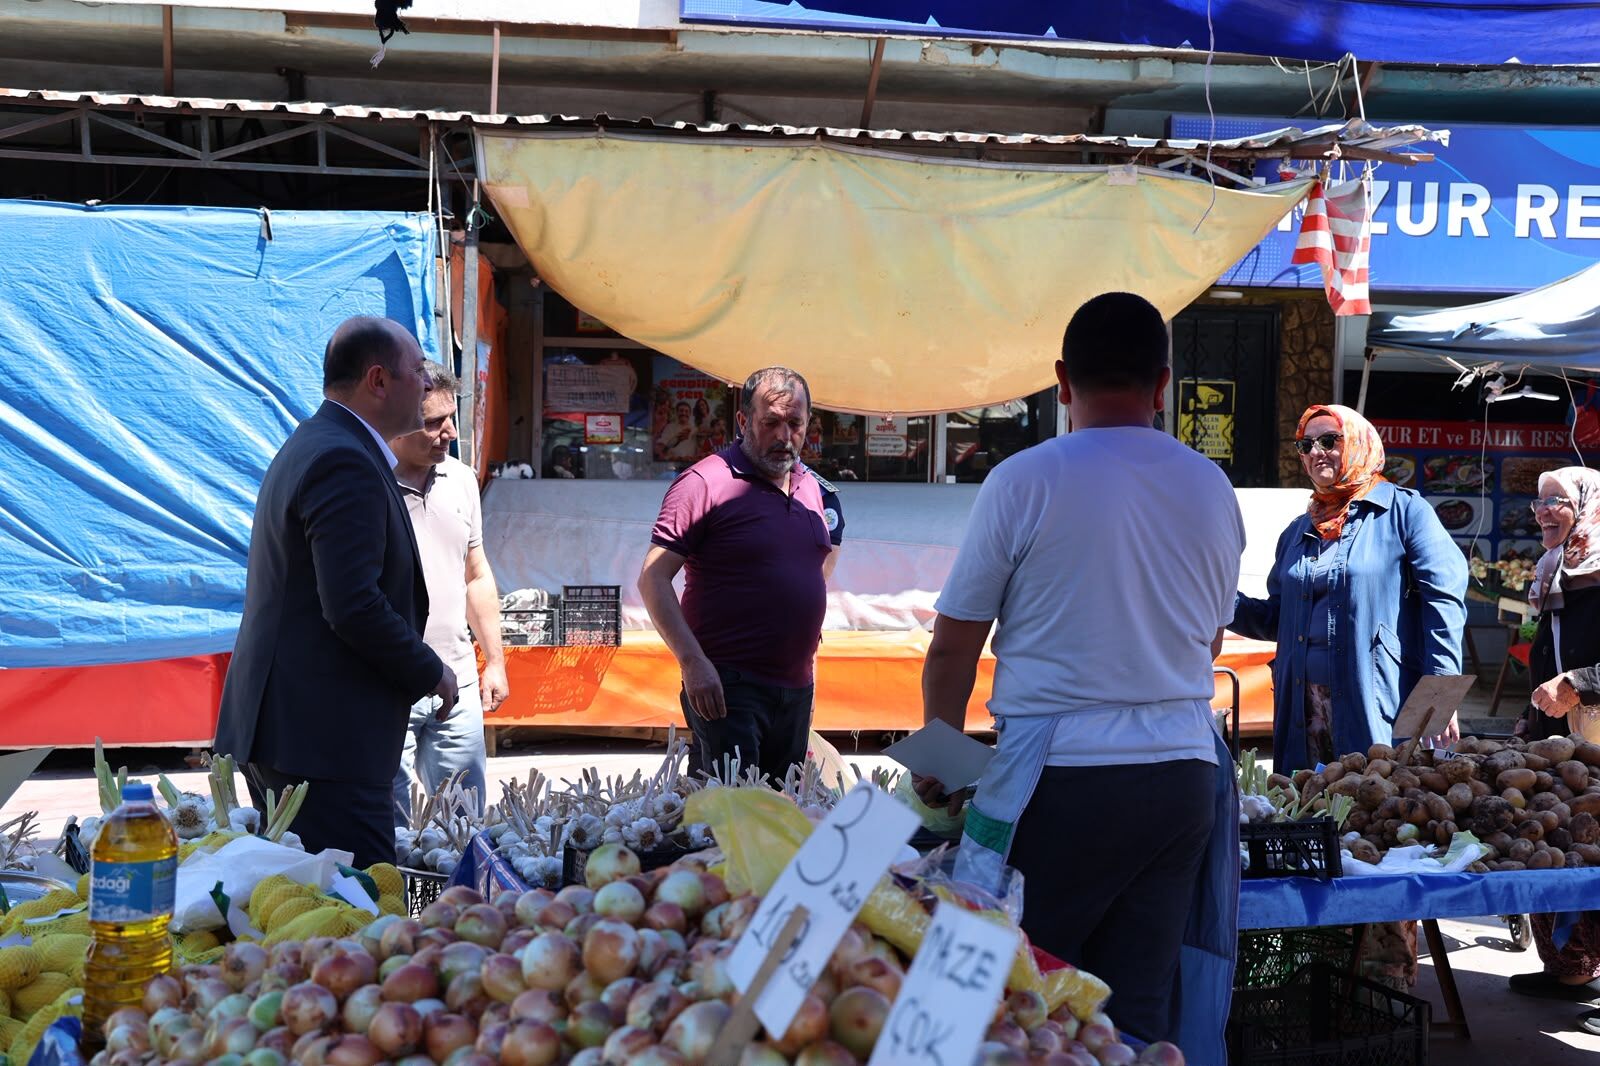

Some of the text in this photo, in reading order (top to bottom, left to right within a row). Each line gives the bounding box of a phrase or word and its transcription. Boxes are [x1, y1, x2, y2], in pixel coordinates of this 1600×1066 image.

[1515, 183, 1600, 239] RE
[1418, 426, 1442, 445] ET
[1447, 432, 1464, 445] ve
[1470, 428, 1524, 448] BALIK
[796, 786, 873, 886] 3
